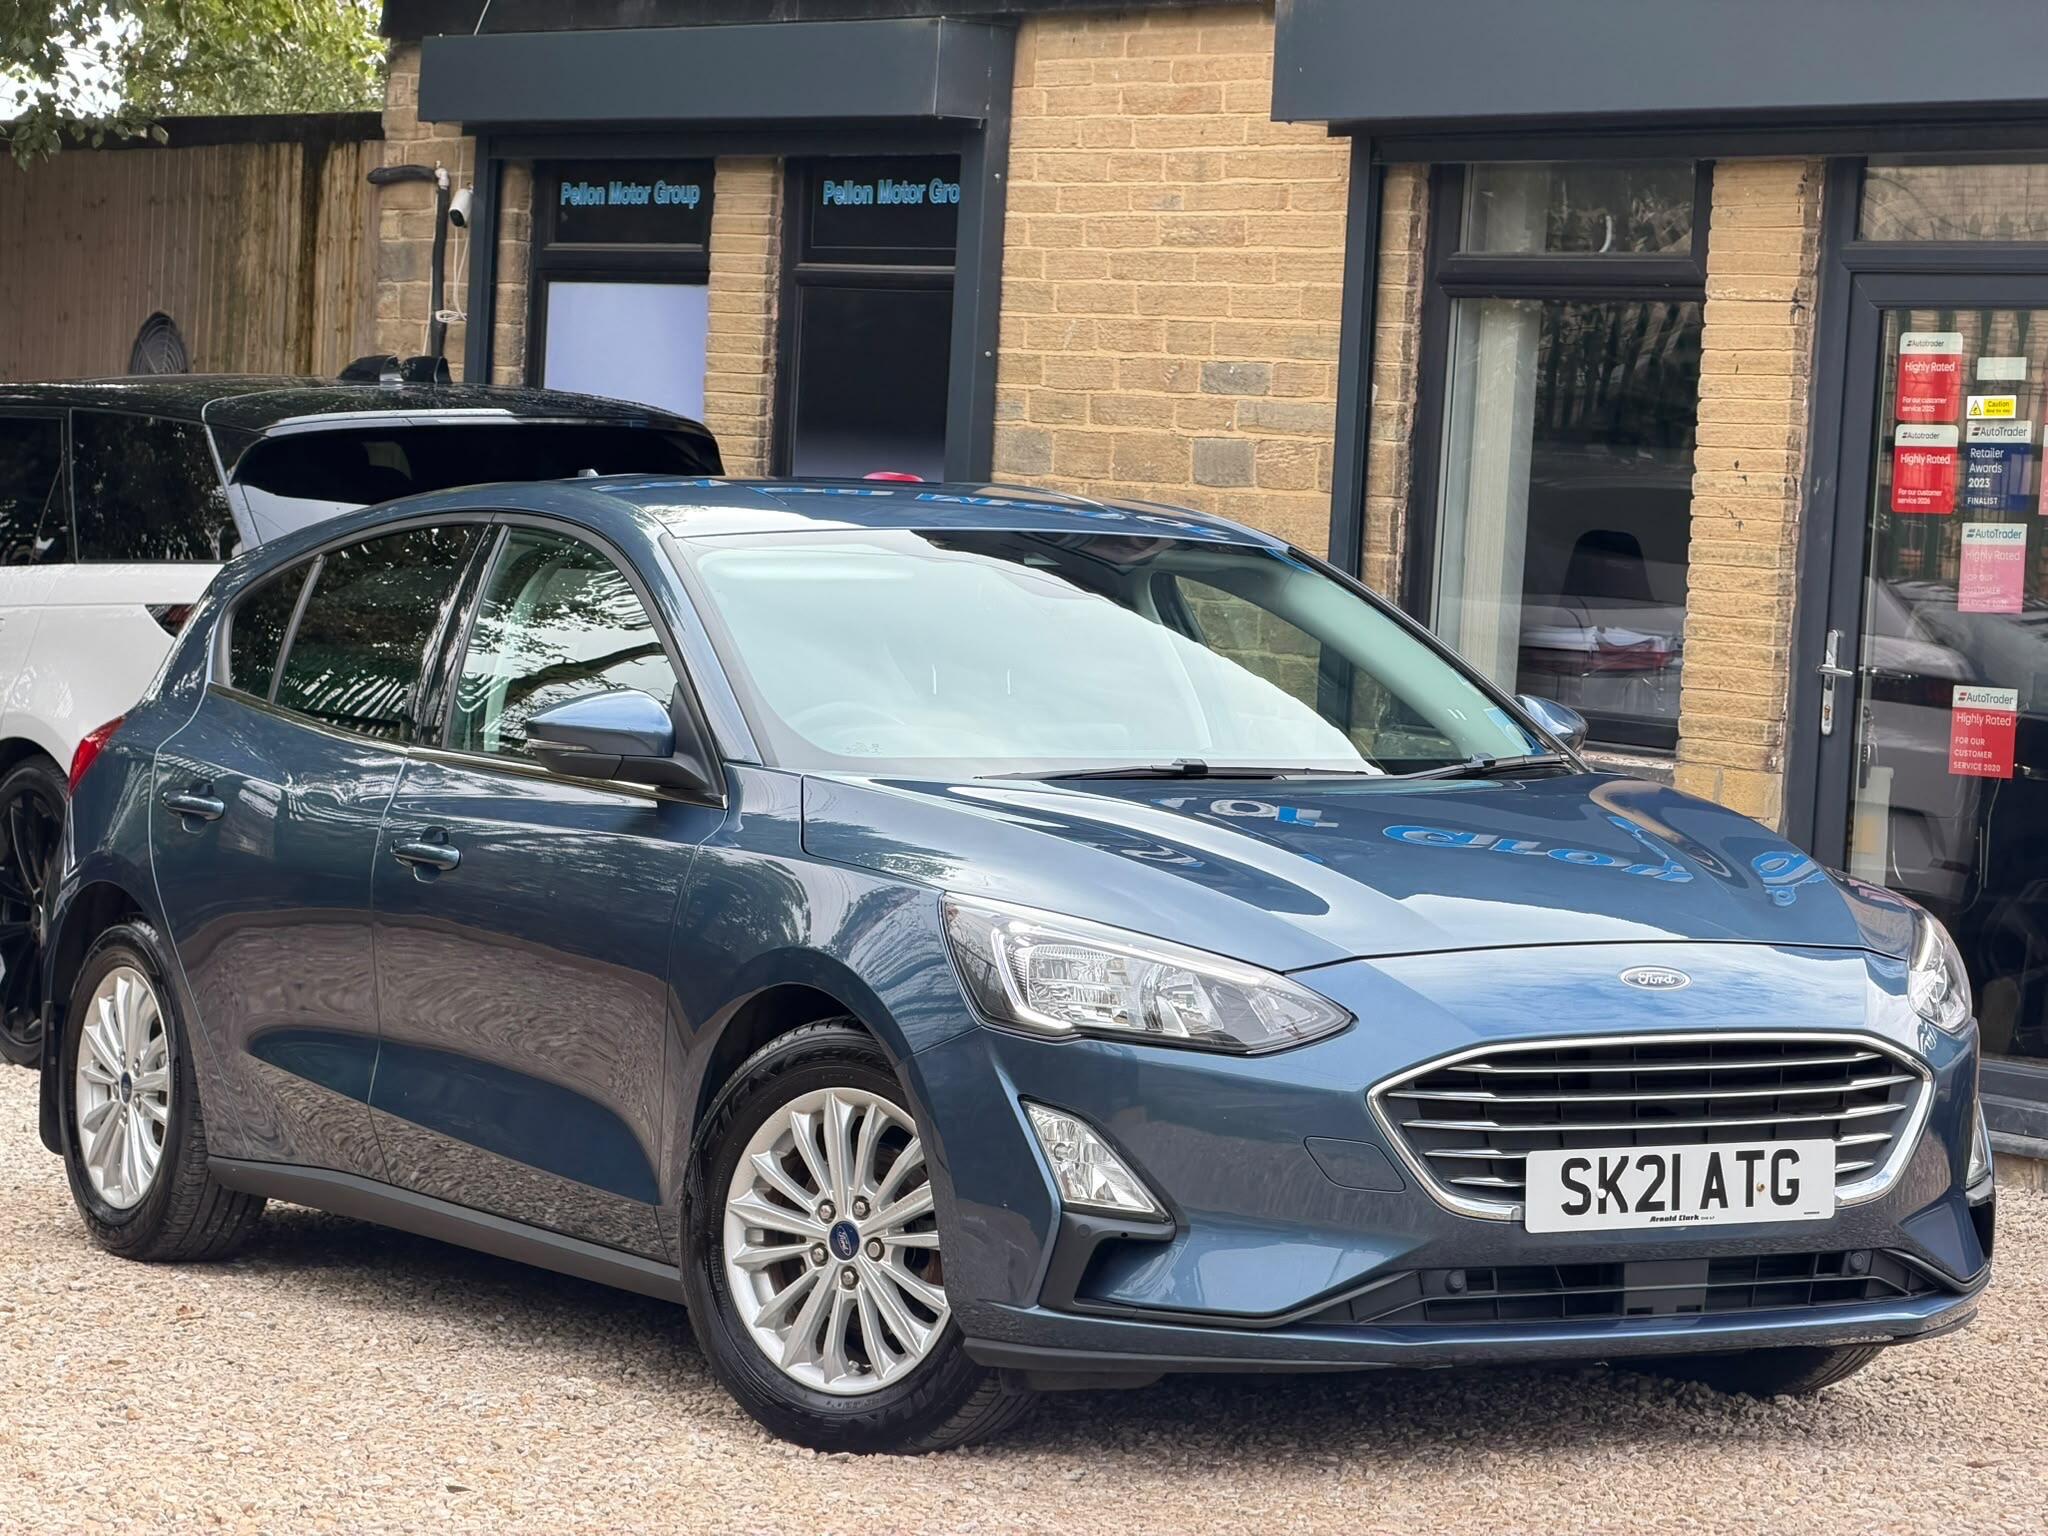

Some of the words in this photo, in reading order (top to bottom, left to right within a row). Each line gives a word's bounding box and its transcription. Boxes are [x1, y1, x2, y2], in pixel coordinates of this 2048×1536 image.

[560, 182, 606, 206] Pellon
[608, 181, 652, 205] Motor
[653, 180, 700, 210] Group
[823, 180, 874, 206] Pellon
[877, 179, 927, 205] Motor
[928, 177, 960, 204] Gro
[1904, 361, 1930, 374] Highly
[1931, 361, 1956, 372] Rated
[1987, 400, 2010, 408] Caution
[1980, 426, 2028, 437] AutoTrader
[1970, 447, 2004, 459] Retailer
[1900, 453, 1925, 466] Highly
[1926, 454, 1951, 465] Rated
[1969, 463, 2003, 474] Awards
[1967, 477, 1991, 488] 2023
[1967, 496, 1999, 505] FINALIST
[1975, 529, 2023, 540] AutoTrader
[1965, 548, 1993, 562] Highly
[1994, 550, 2021, 561] Rated
[1966, 692, 2014, 705] AutoTrader
[1956, 712, 1985, 727] Highly
[1985, 715, 2012, 727] Rated
[1955, 736, 1969, 745] FOR
[1970, 737, 1986, 746] OUR
[1953, 749, 1993, 759] CUSTOMER
[1953, 761, 1982, 771] SERVICE
[1561, 1153, 1682, 1216] SK21
[1700, 1148, 1801, 1210] ATG
[1649, 1214, 1678, 1223] Arnold
[1678, 1214, 1700, 1222] Clark
